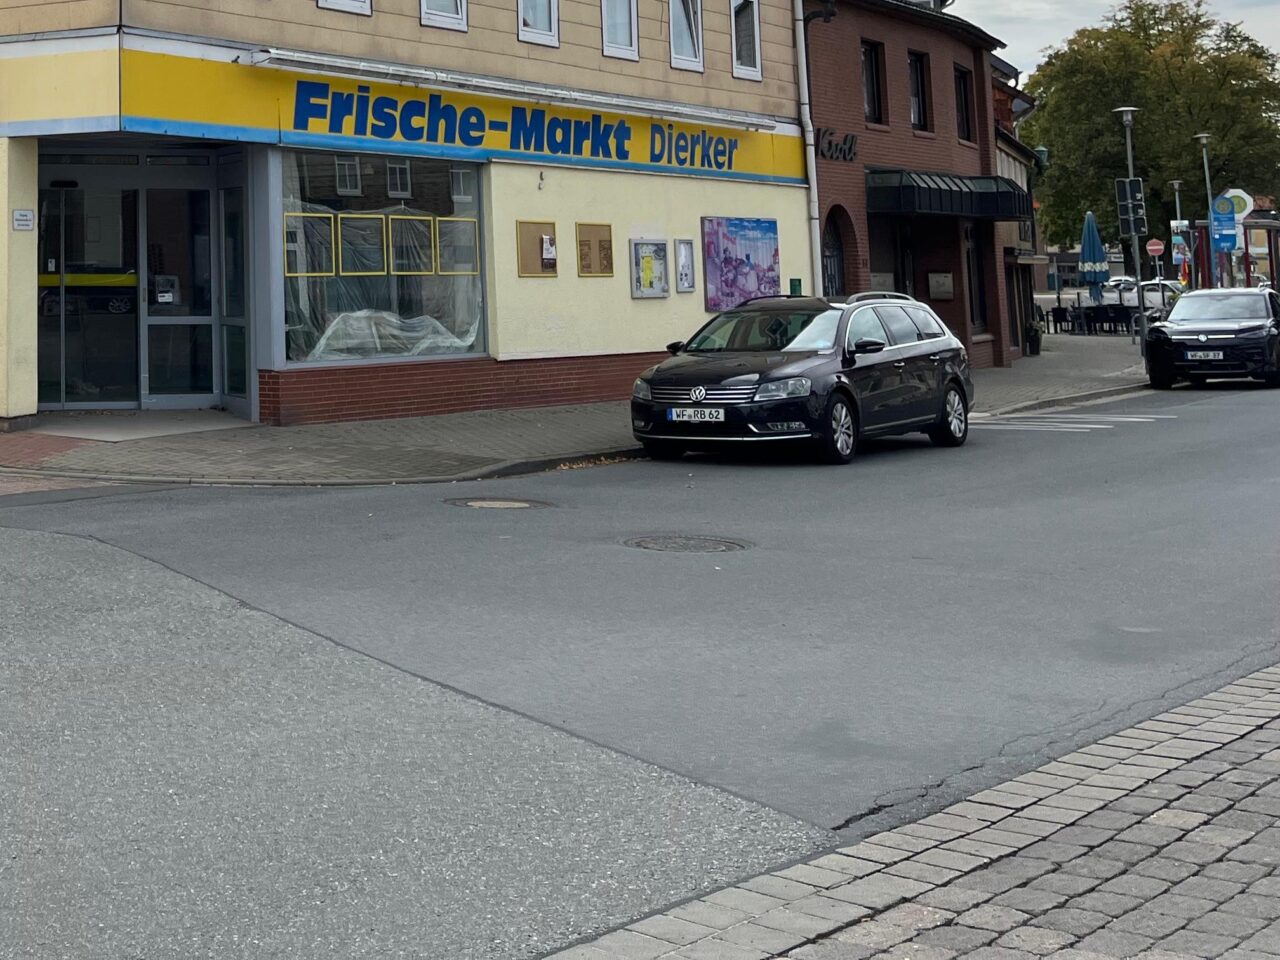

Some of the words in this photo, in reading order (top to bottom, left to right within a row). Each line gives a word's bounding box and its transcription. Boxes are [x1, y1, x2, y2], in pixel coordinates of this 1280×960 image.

[293, 79, 632, 161] Frische-Markt
[649, 122, 739, 171] Dierker
[675, 409, 687, 419] WF
[693, 409, 706, 419] RB
[708, 409, 721, 419] 62
